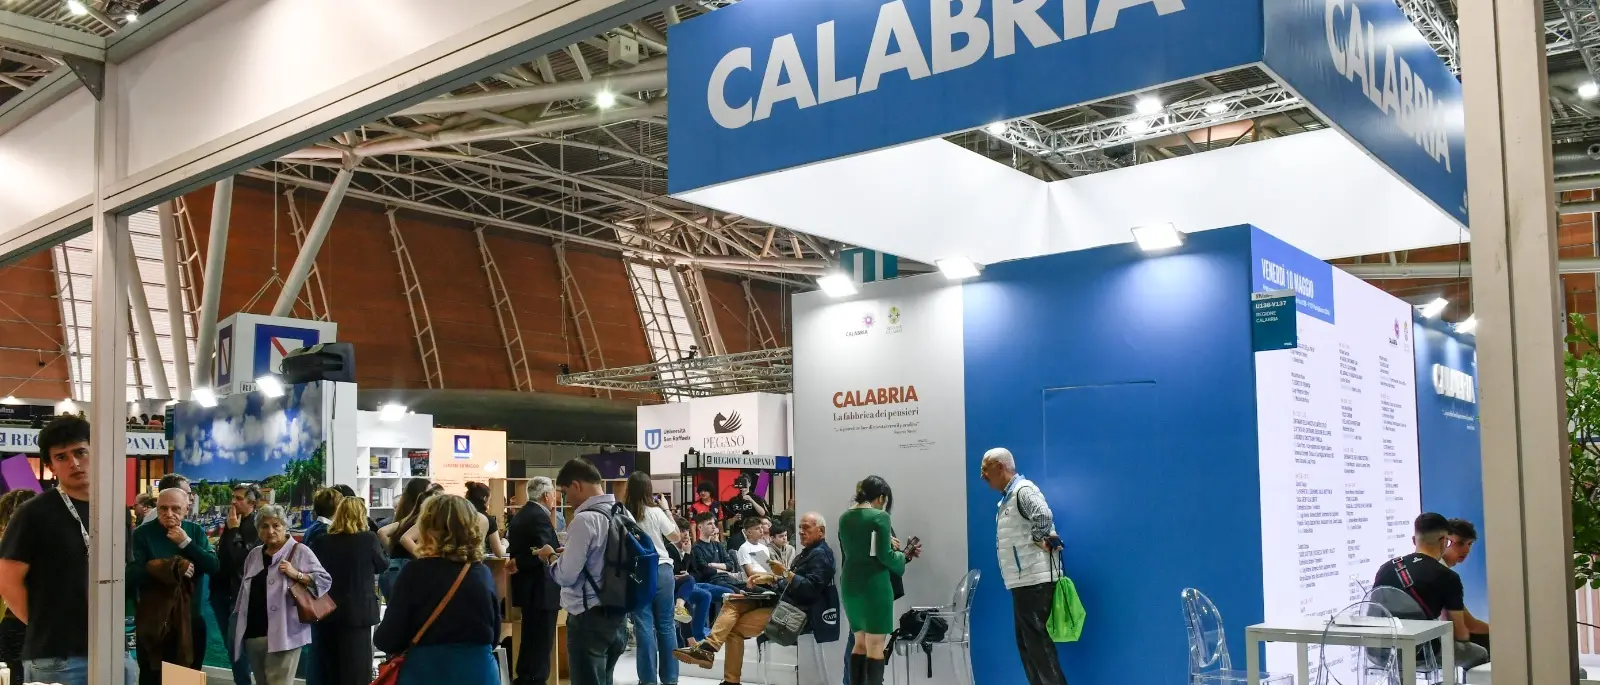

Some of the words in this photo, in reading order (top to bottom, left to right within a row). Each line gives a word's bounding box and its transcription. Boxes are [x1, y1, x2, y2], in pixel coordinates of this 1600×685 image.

[1325, 0, 1452, 173] CALABRIA
[832, 385, 919, 409] CALABRIA
[833, 412, 843, 422] La
[843, 409, 875, 421] fabbrica
[875, 408, 887, 419] dei
[888, 406, 919, 420] pensieri
[703, 434, 745, 449] PEGASO
[713, 456, 742, 465] REGIONE
[743, 456, 775, 466] CAMPANIA
